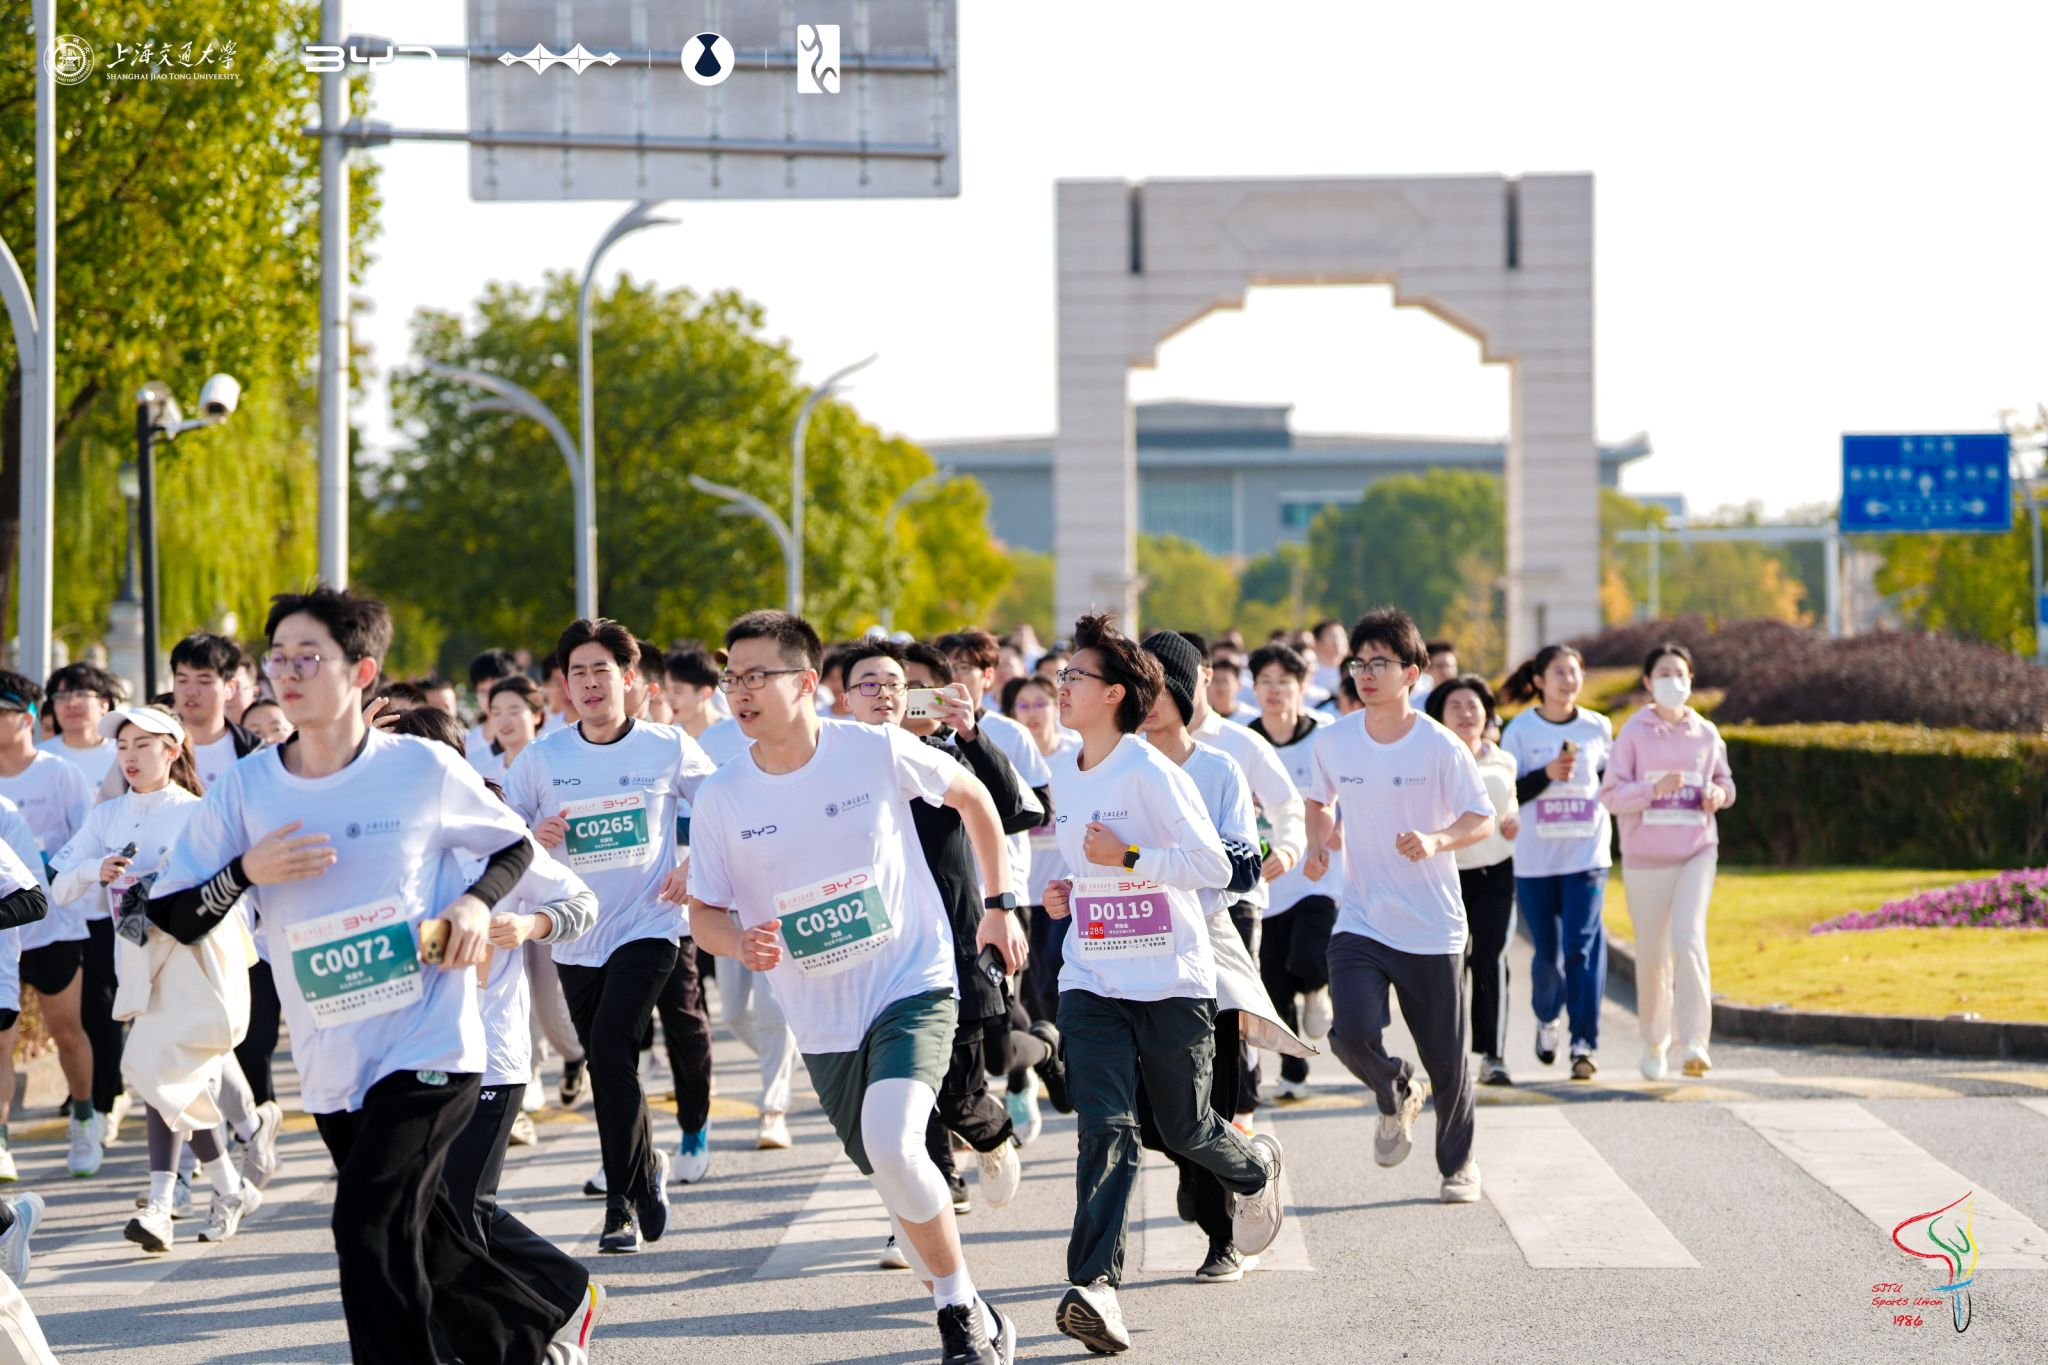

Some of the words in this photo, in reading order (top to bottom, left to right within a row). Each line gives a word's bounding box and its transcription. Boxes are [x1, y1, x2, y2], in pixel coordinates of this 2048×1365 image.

[602, 797, 640, 809] BYD
[576, 815, 634, 838] C0265
[741, 825, 777, 840] BYD
[822, 873, 868, 896] BYD
[343, 906, 396, 931] BYD
[796, 899, 868, 936] C0302
[1089, 901, 1153, 921] D0119
[1090, 927, 1104, 935] 285
[310, 935, 395, 976] C0072
